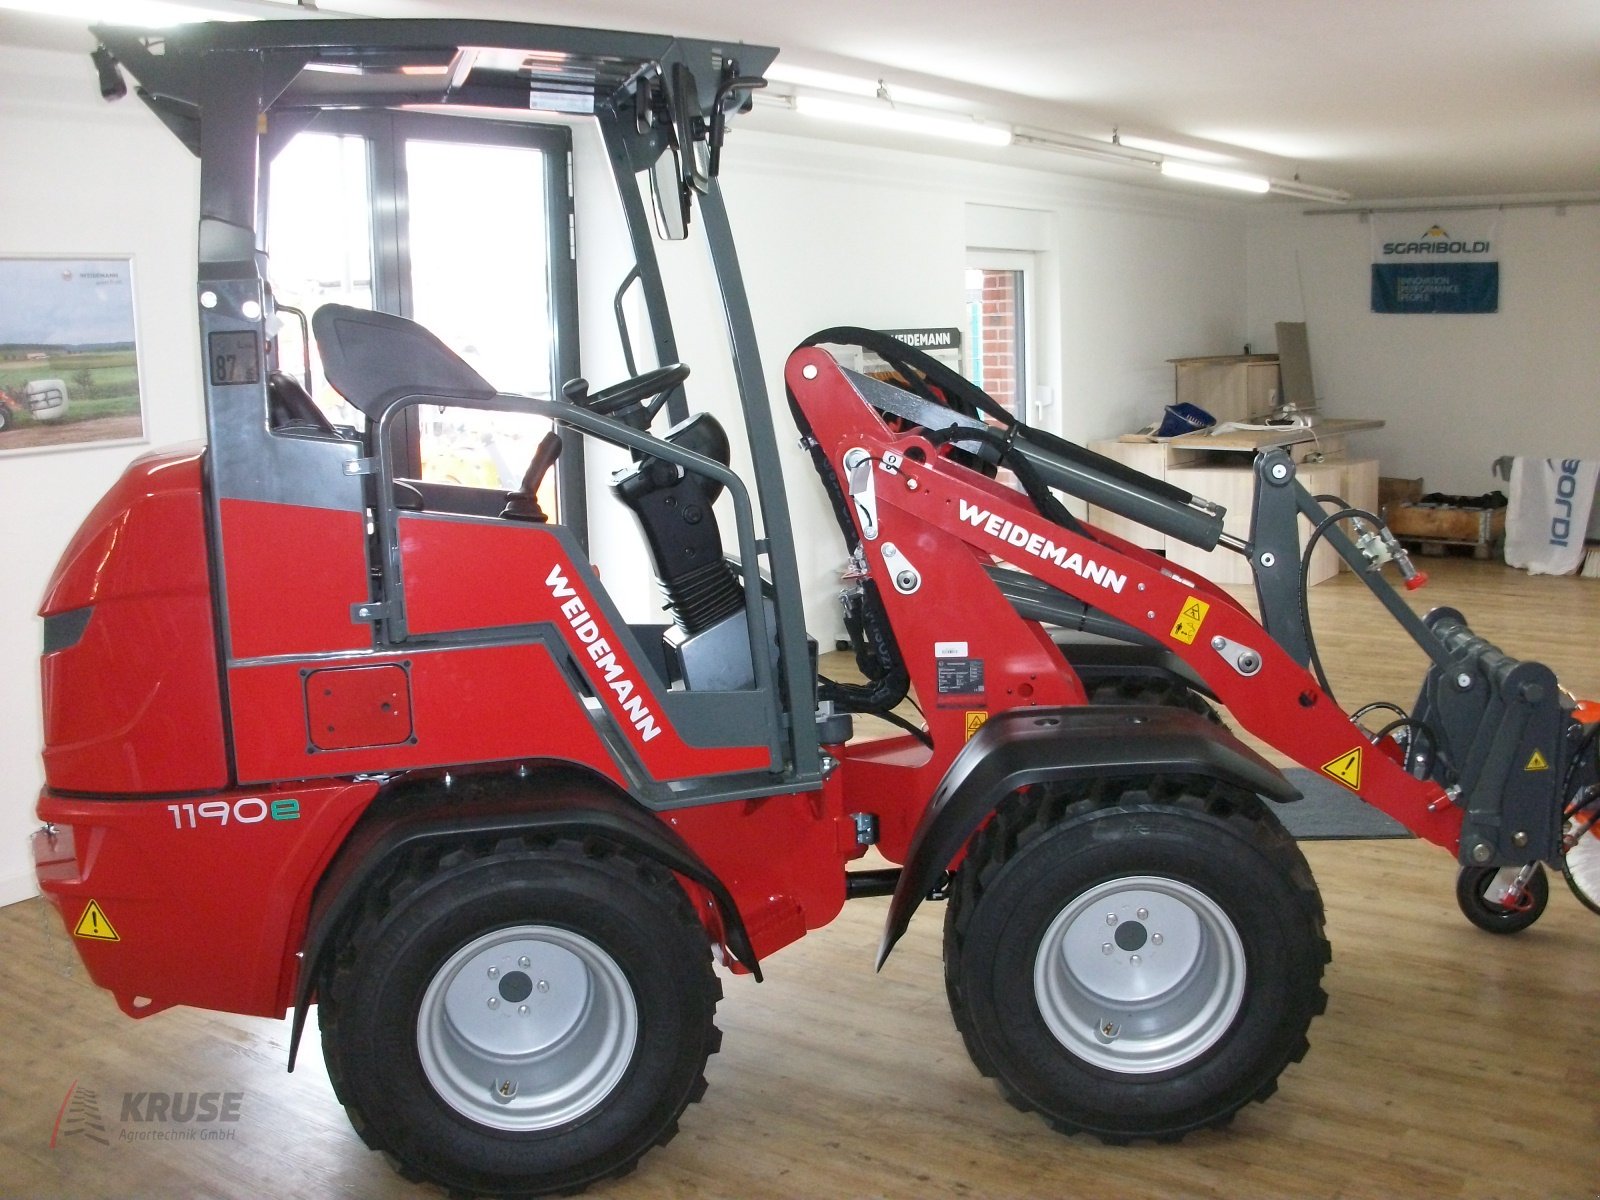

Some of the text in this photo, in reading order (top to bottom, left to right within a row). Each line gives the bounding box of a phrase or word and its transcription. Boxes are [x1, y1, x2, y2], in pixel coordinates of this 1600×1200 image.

[1383, 241, 1490, 254] SGARIBOLDI
[891, 333, 951, 347] EIDEMANN
[216, 354, 237, 381] 87
[959, 499, 1127, 594] WEIDEMANN
[545, 563, 662, 742] WEIDEMANN
[167, 798, 300, 829] 1190e
